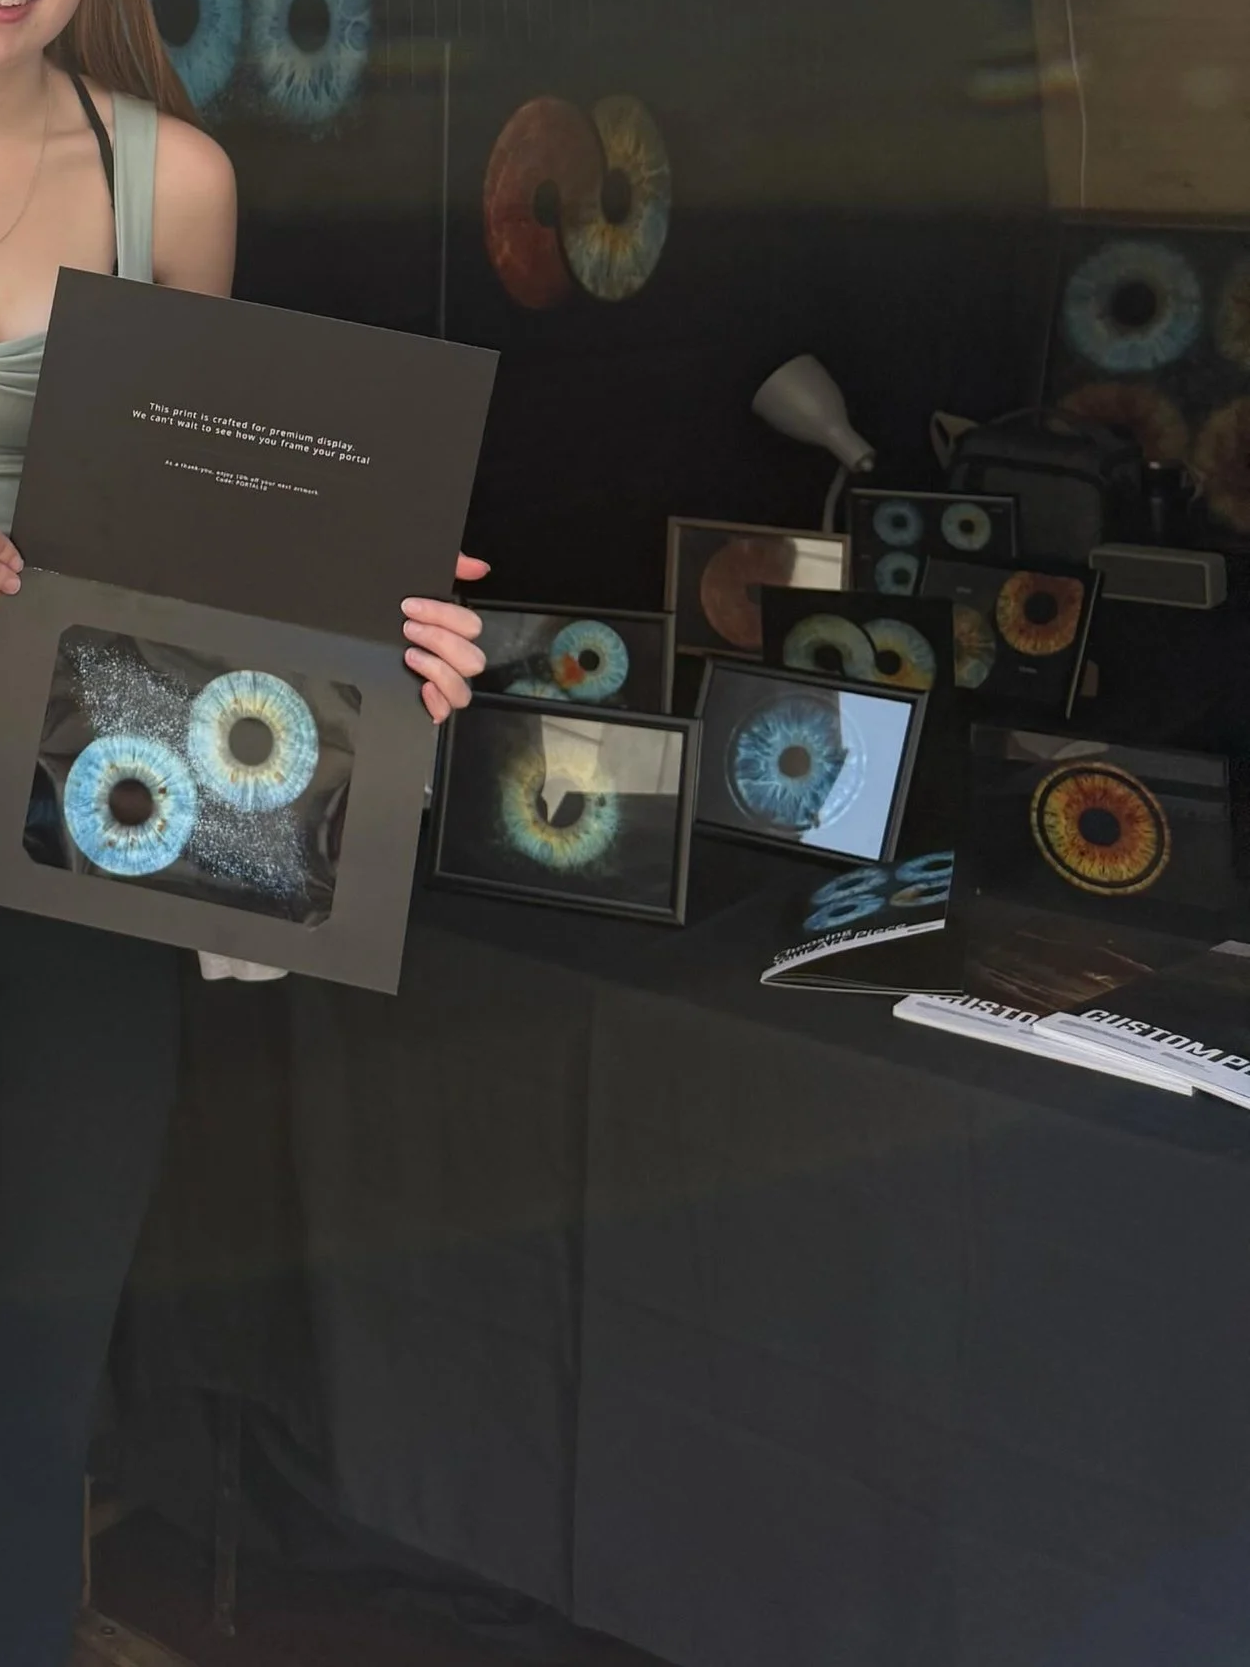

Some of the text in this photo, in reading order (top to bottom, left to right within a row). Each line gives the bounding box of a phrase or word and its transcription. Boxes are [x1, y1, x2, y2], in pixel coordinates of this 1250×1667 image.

[132, 409, 370, 465] We can't wait to see how you frame your portal
[149, 402, 356, 452] This print is crafted for premium display.
[1079, 1009, 1224, 1063] CUSTOM
